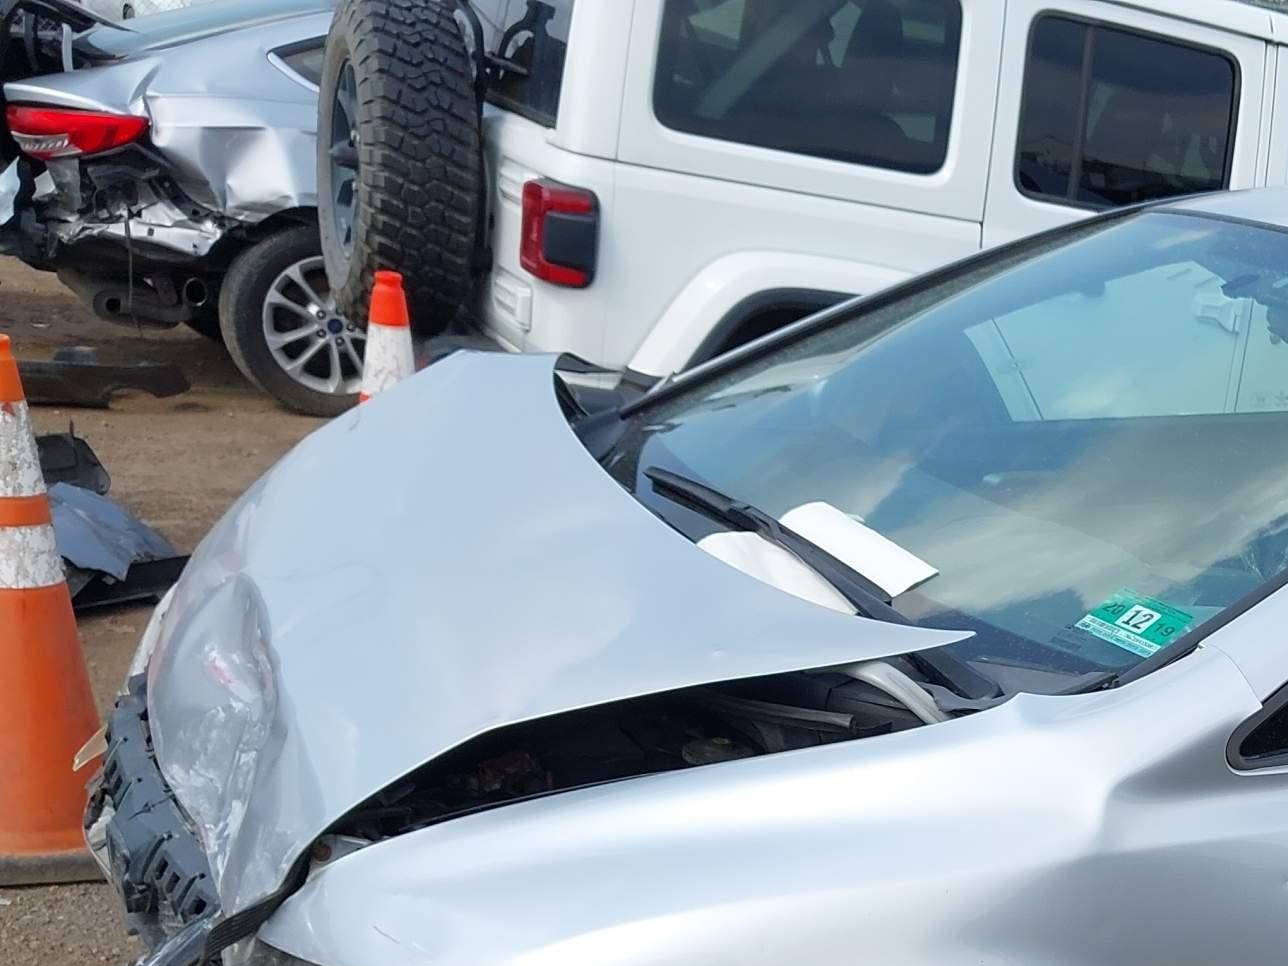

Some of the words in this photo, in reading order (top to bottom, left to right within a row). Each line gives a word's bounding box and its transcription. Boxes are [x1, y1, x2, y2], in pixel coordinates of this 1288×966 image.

[1102, 601, 1125, 616] 20
[1121, 608, 1155, 630] 12
[1153, 622, 1176, 637] 19
